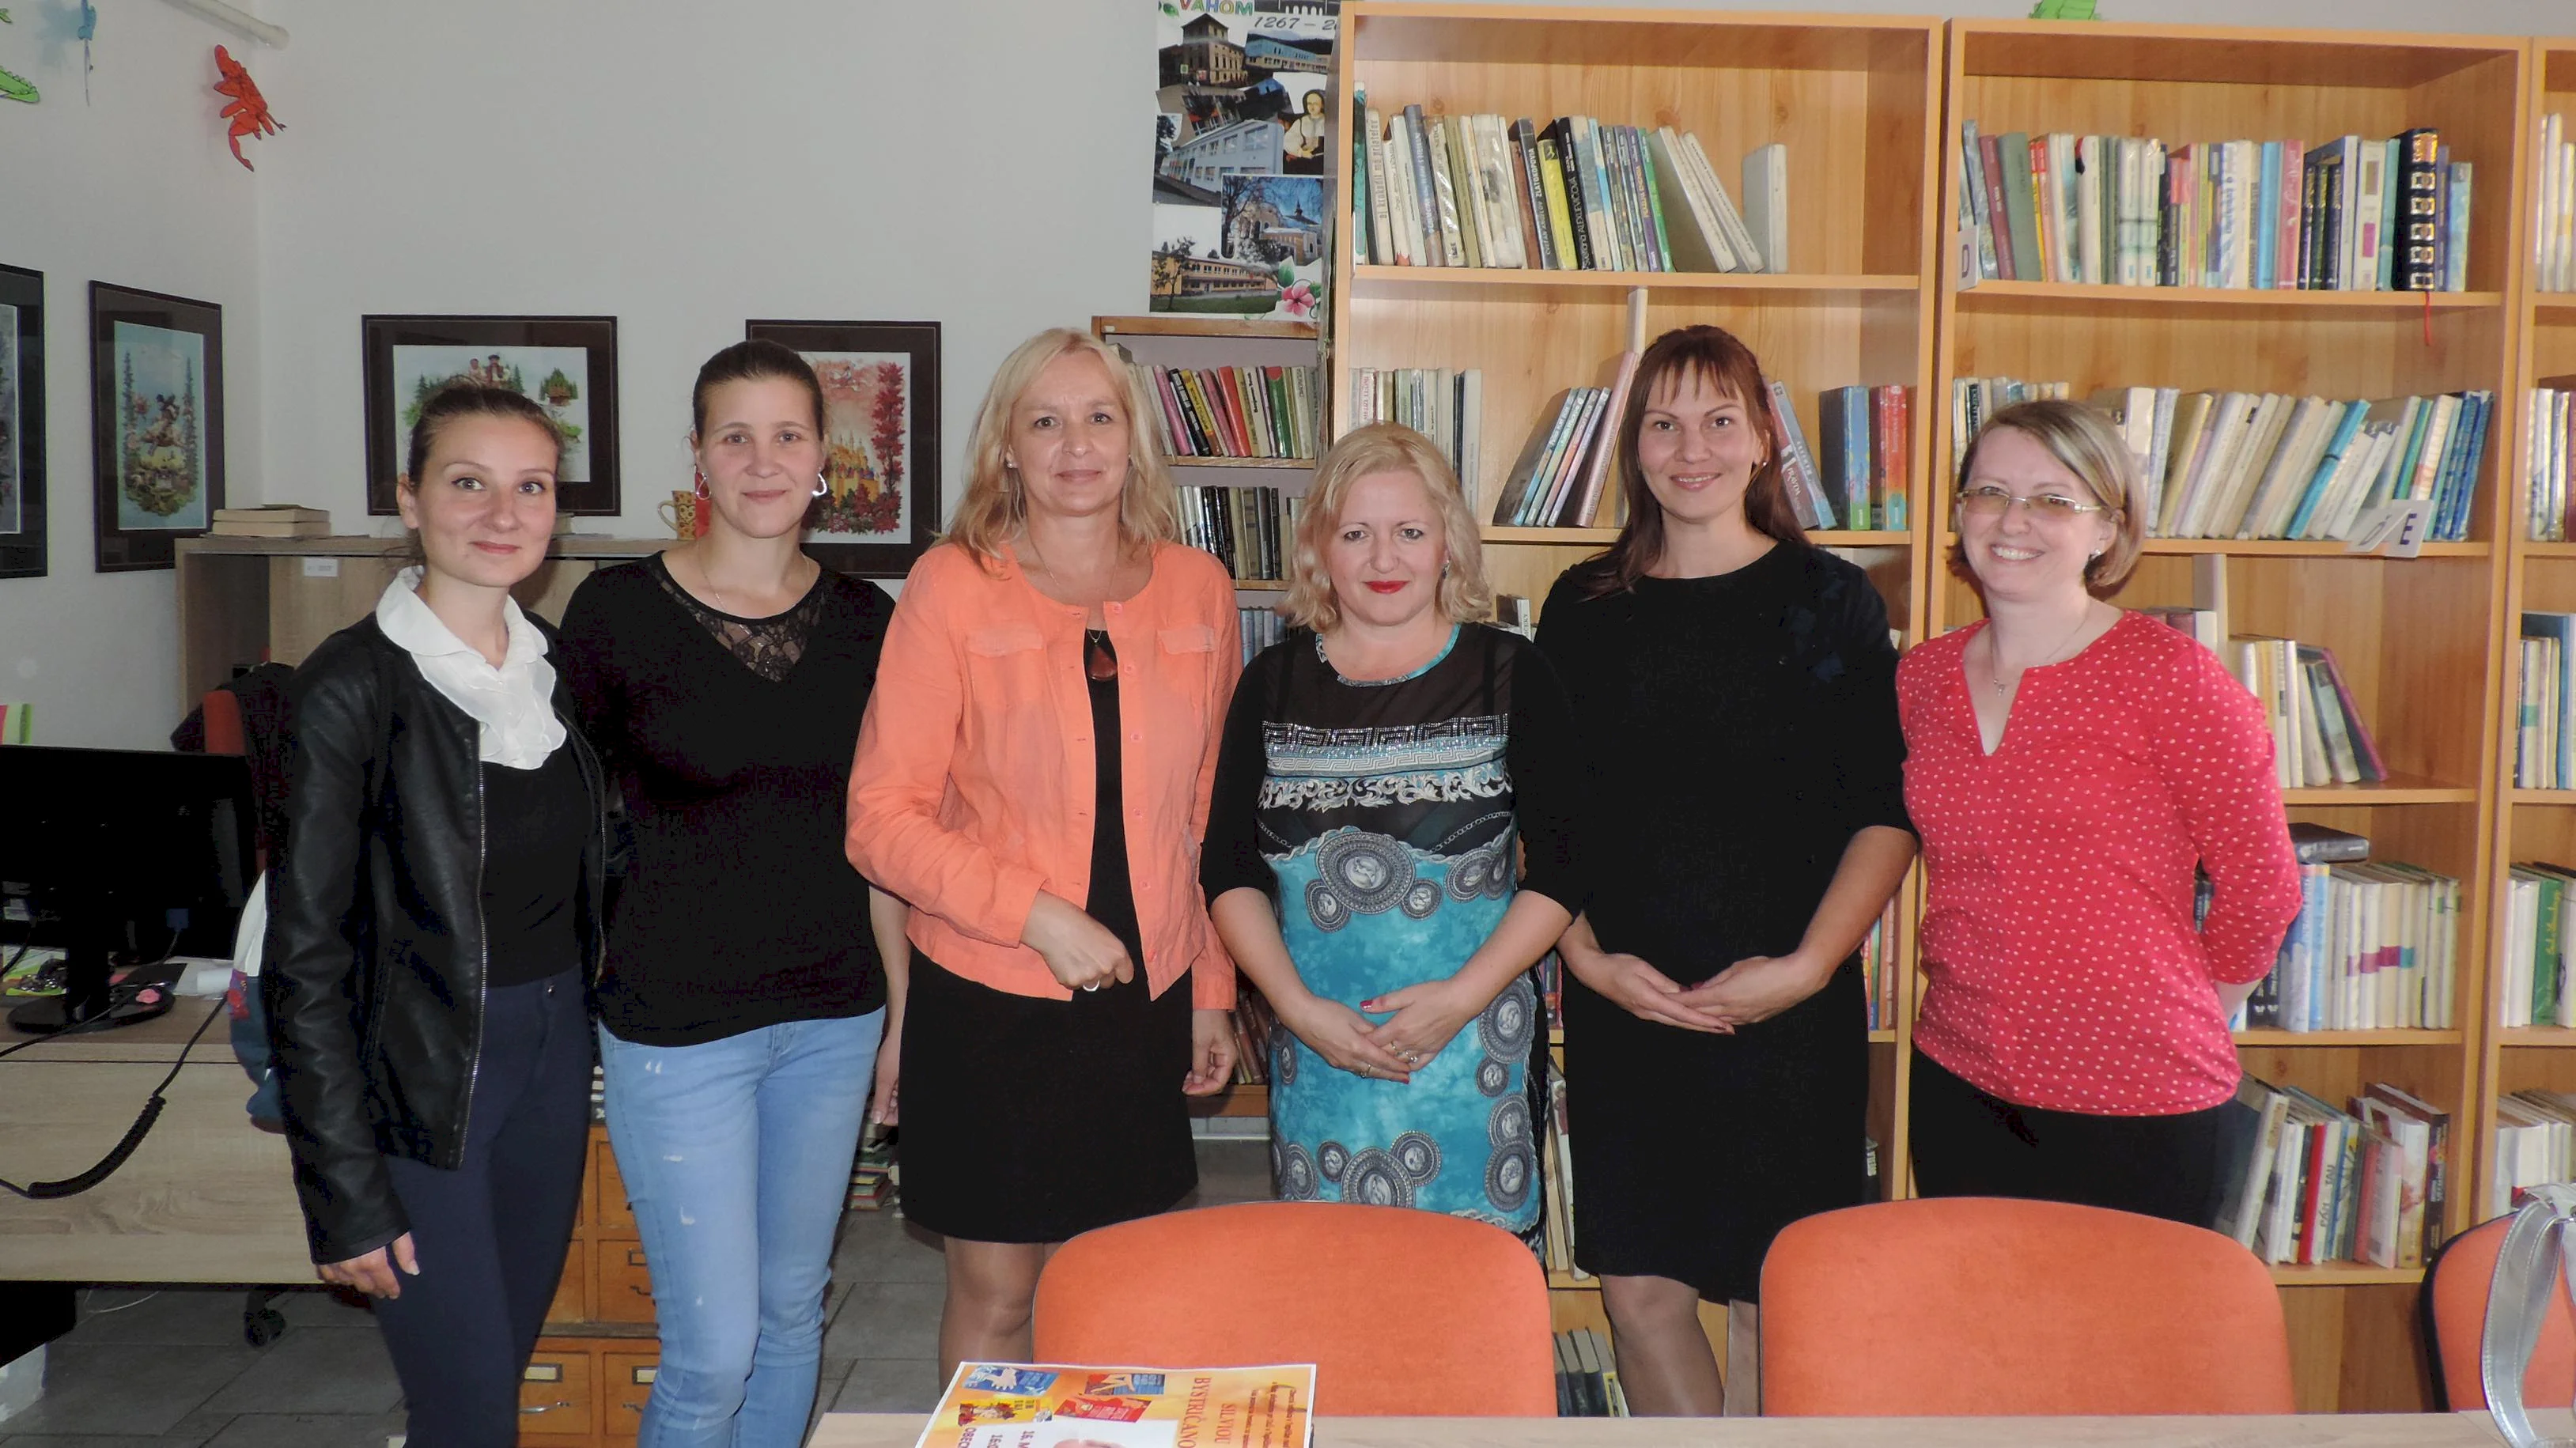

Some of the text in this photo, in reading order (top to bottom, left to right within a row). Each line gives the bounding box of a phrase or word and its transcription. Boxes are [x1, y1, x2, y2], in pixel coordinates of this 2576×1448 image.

[1254, 17, 1299, 29] 1267
[1526, 147, 1542, 198] ZLATOKOPOVIA
[2400, 512, 2418, 546] E
[956, 1427, 977, 1448] OBEC
[1215, 1404, 1237, 1444] SILVIOU
